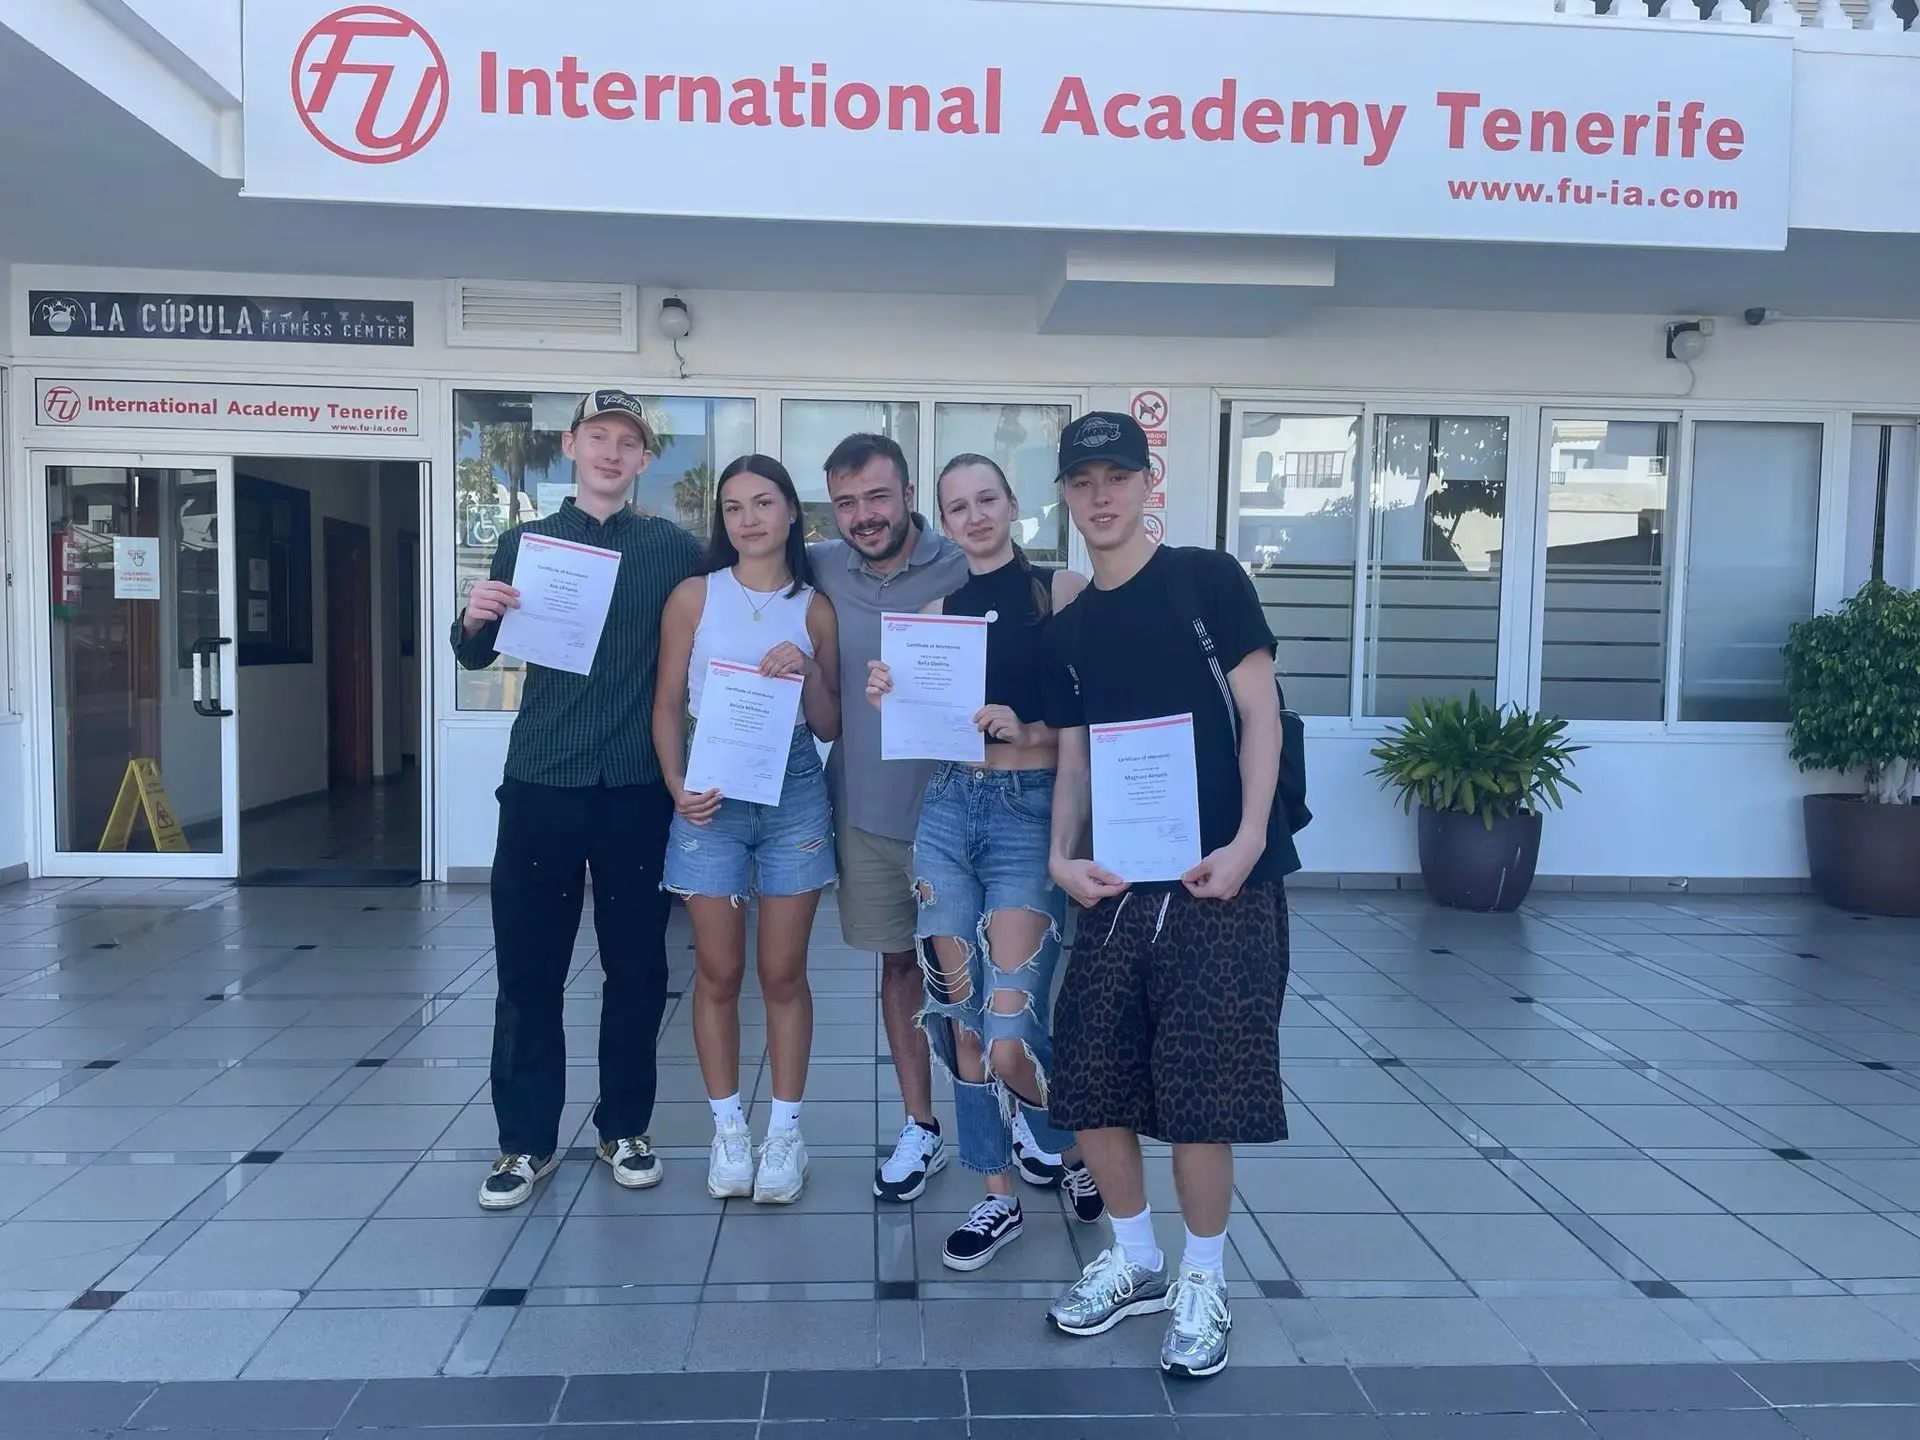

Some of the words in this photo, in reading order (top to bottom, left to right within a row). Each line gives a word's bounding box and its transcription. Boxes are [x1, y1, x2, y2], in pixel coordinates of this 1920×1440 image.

[480, 51, 1001, 134] International
[1043, 76, 1405, 165] Academy
[1437, 92, 1743, 159] Tenerife
[1450, 178, 1737, 207] www.fu-ia.com
[91, 302, 125, 331] LA
[142, 299, 254, 335] CÚPULA
[261, 321, 332, 337] FITNESS
[343, 324, 407, 340] CENTER
[87, 395, 218, 416] International
[227, 400, 320, 422] Academy
[327, 404, 408, 421] Tenerife
[331, 424, 407, 433] www.fu-ia.com
